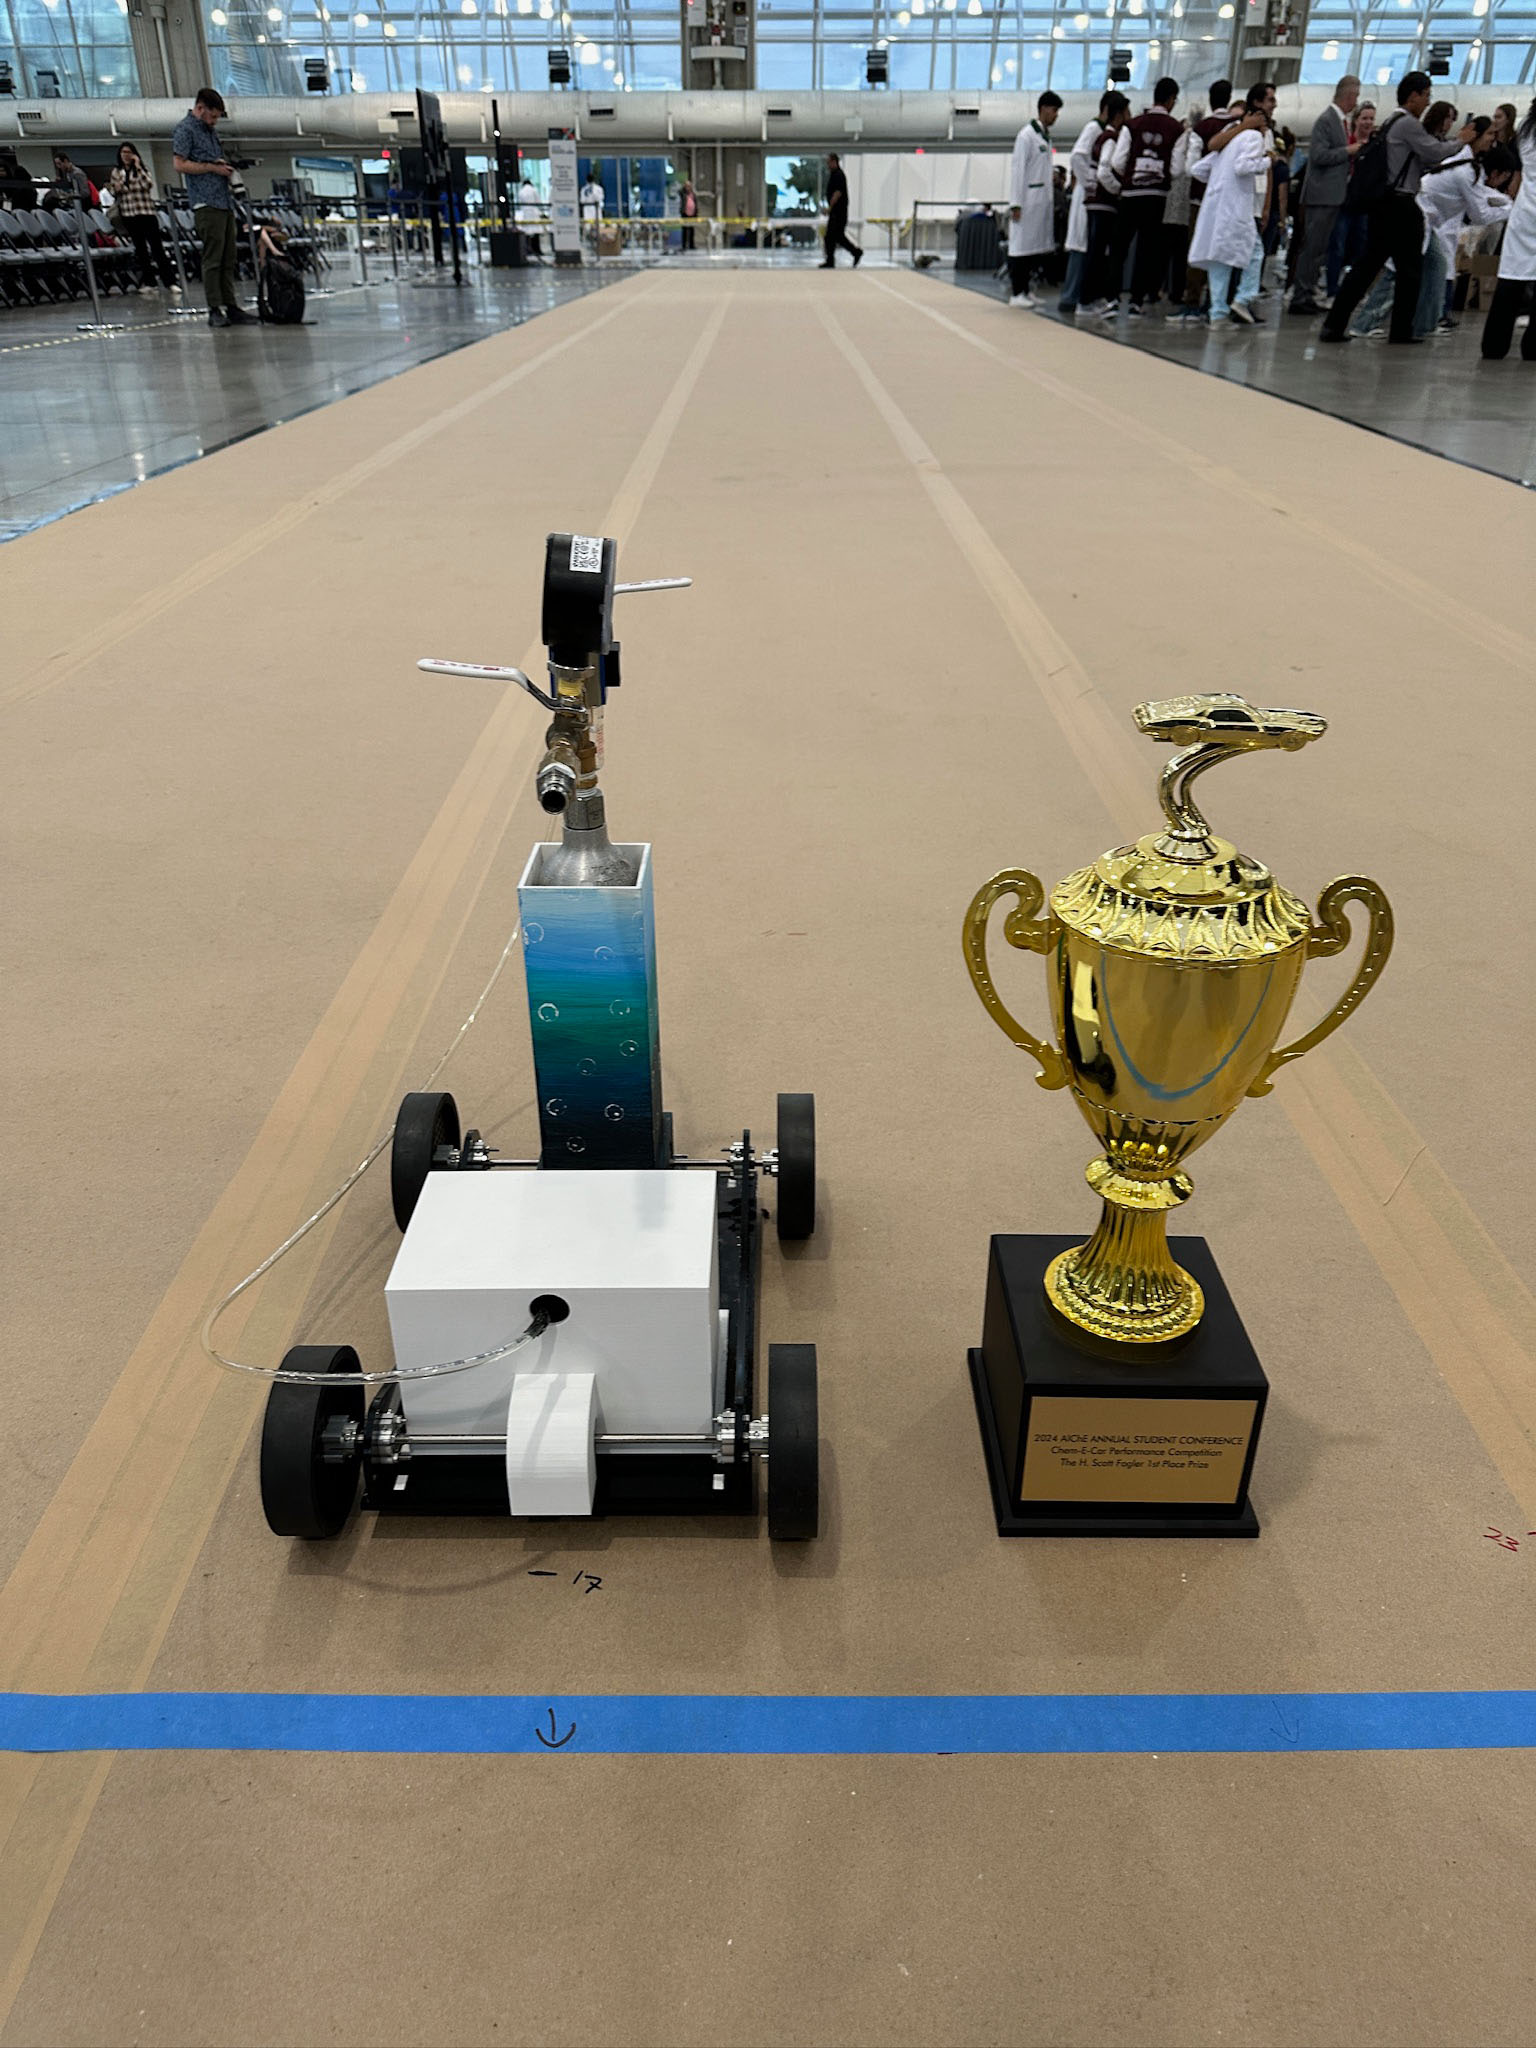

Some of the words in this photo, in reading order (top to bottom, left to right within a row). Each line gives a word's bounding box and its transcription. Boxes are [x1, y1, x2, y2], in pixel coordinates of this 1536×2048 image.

[1033, 1433, 1059, 1443] 2024
[1061, 1434, 1089, 1443] AIChE
[1090, 1435, 1131, 1444] ANNUAL
[1133, 1435, 1178, 1444] STUDENT
[1179, 1436, 1244, 1446] CONFERENCE
[1051, 1446, 1107, 1455] Chem-E-Car
[1108, 1446, 1166, 1456] Performance
[1167, 1447, 1224, 1458] Competition
[1060, 1457, 1077, 1467] The
[1079, 1458, 1089, 1467] H.
[1091, 1458, 1115, 1468] Scott
[1116, 1459, 1145, 1470] Fogler
[1147, 1460, 1162, 1469] 1st
[1162, 1460, 1187, 1469] Place
[1187, 1460, 1210, 1470] Prize
